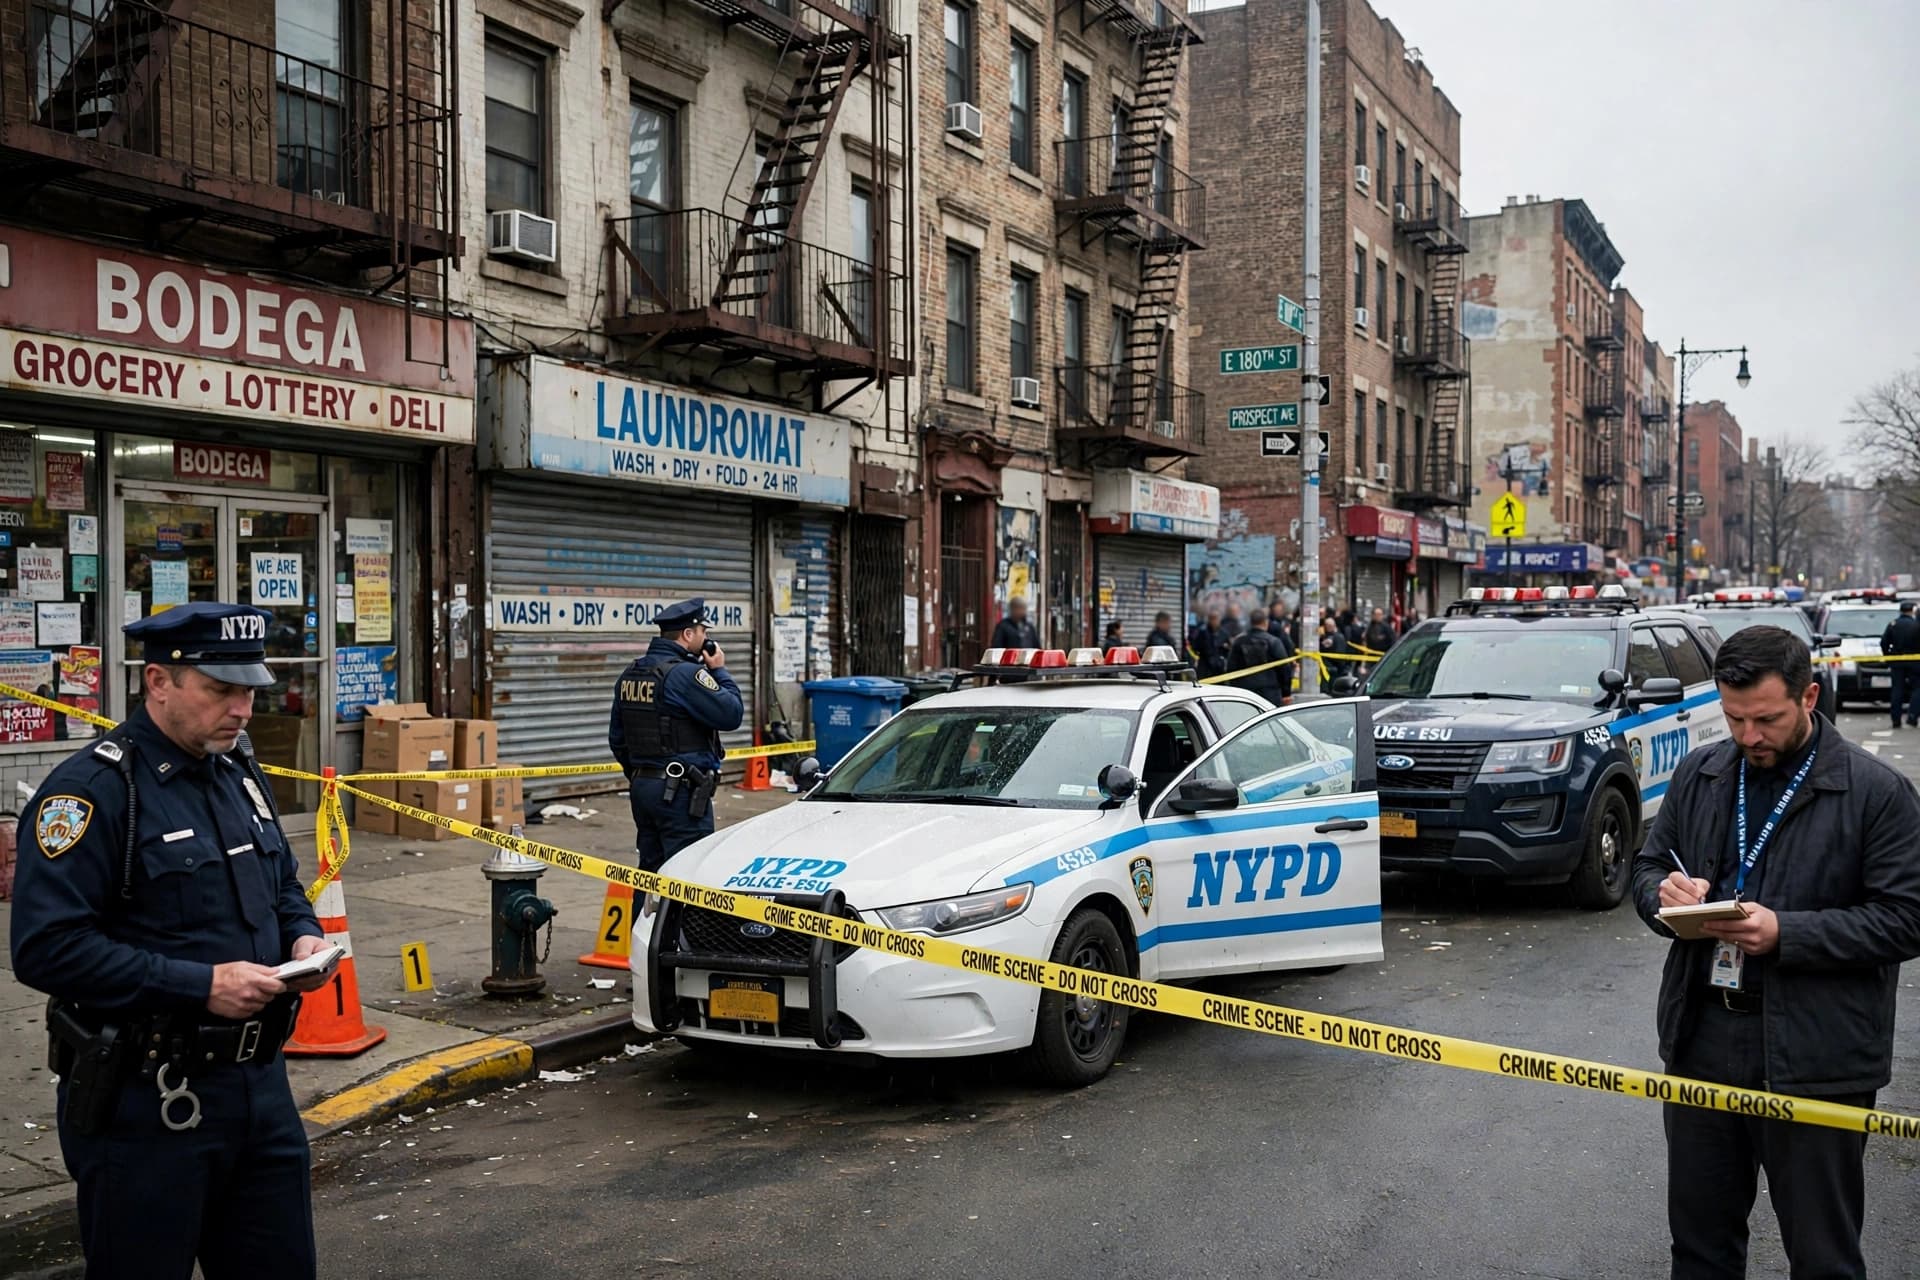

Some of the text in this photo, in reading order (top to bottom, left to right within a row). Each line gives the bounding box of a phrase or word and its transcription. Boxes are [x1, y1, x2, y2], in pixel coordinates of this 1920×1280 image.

[97, 258, 366, 372] BODEGA
[1225, 349, 1292, 370] E 180TH ST
[14, 340, 445, 433] GROCERY LOTTERY DELI
[597, 381, 805, 468] LAUNDROMAT
[1232, 407, 1295, 426] PROSPECT AVE
[180, 447, 265, 479] BODEGA
[612, 449, 798, 494] WASH DRY FOLD 24 HR
[256, 559, 297, 575] WE ARE
[258, 578, 298, 599] OPEN
[220, 614, 266, 640] NYPD
[501, 600, 550, 626] WASH
[573, 602, 605, 626] DRY
[724, 606, 742, 627] HR
[620, 680, 655, 703] POLICE
[756, 760, 765, 778] 2
[1650, 728, 1688, 776] NYPD
[738, 856, 847, 879] NYPD
[1057, 846, 1097, 872] 4529
[1187, 842, 1341, 908] NYPD
[605, 864, 631, 884] CRIME
[633, 872, 660, 892] SCENE
[669, 882, 681, 898] DO
[684, 886, 703, 904] NOT
[704, 892, 735, 912] CROSS
[605, 905, 623, 942] 2
[764, 906, 796, 927] CRIME
[798, 915, 832, 936] SCENE
[843, 925, 858, 941] DO
[862, 929, 882, 948] NOT
[887, 936, 925, 958] CROSS
[407, 947, 423, 984] 1
[961, 949, 1001, 974] CRIME
[1004, 958, 1045, 984] SCENE
[1059, 970, 1077, 991] DO
[1081, 975, 1108, 997] NOT
[1111, 981, 1158, 1007] CROSS
[332, 973, 344, 1016] 1
[1203, 999, 1250, 1025] CRIME
[1255, 1009, 1305, 1036] SCENE
[1321, 1021, 1343, 1042] DO
[1349, 1027, 1381, 1050] NOT
[1386, 1033, 1442, 1061] CROSS
[1499, 1053, 1557, 1081] CRIME
[1563, 1064, 1624, 1093] SCENE
[1645, 1078, 1672, 1100] DO
[1680, 1084, 1719, 1108] NOT
[1727, 1092, 1794, 1121] CROSS
[1864, 1113, 1920, 1139] CRIM
